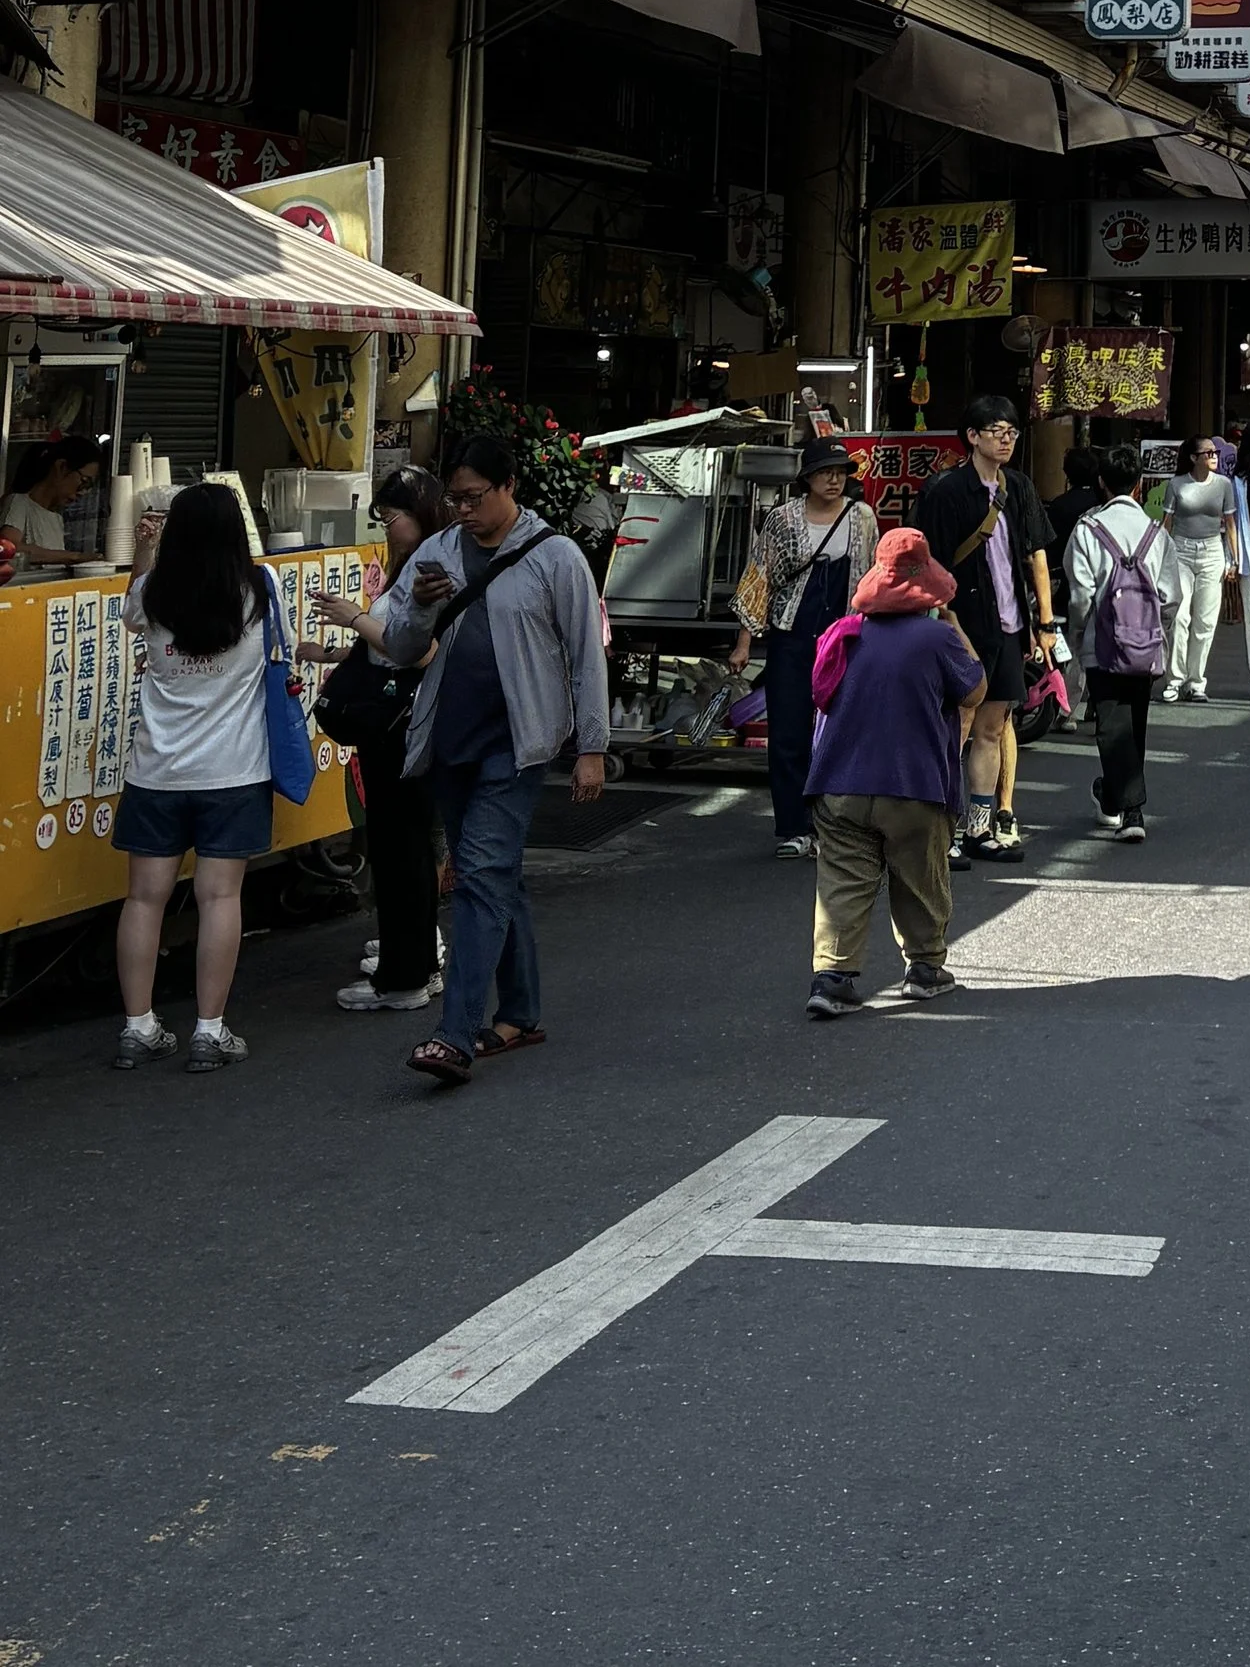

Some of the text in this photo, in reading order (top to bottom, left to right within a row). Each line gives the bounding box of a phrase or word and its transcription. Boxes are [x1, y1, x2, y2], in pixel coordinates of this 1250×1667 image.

[1097, 2, 1173, 25] 鳳梨店
[875, 258, 1007, 315] 牛肉湯
[870, 443, 940, 480] 潘家
[68, 804, 84, 828] 85
[96, 809, 111, 834] 95
